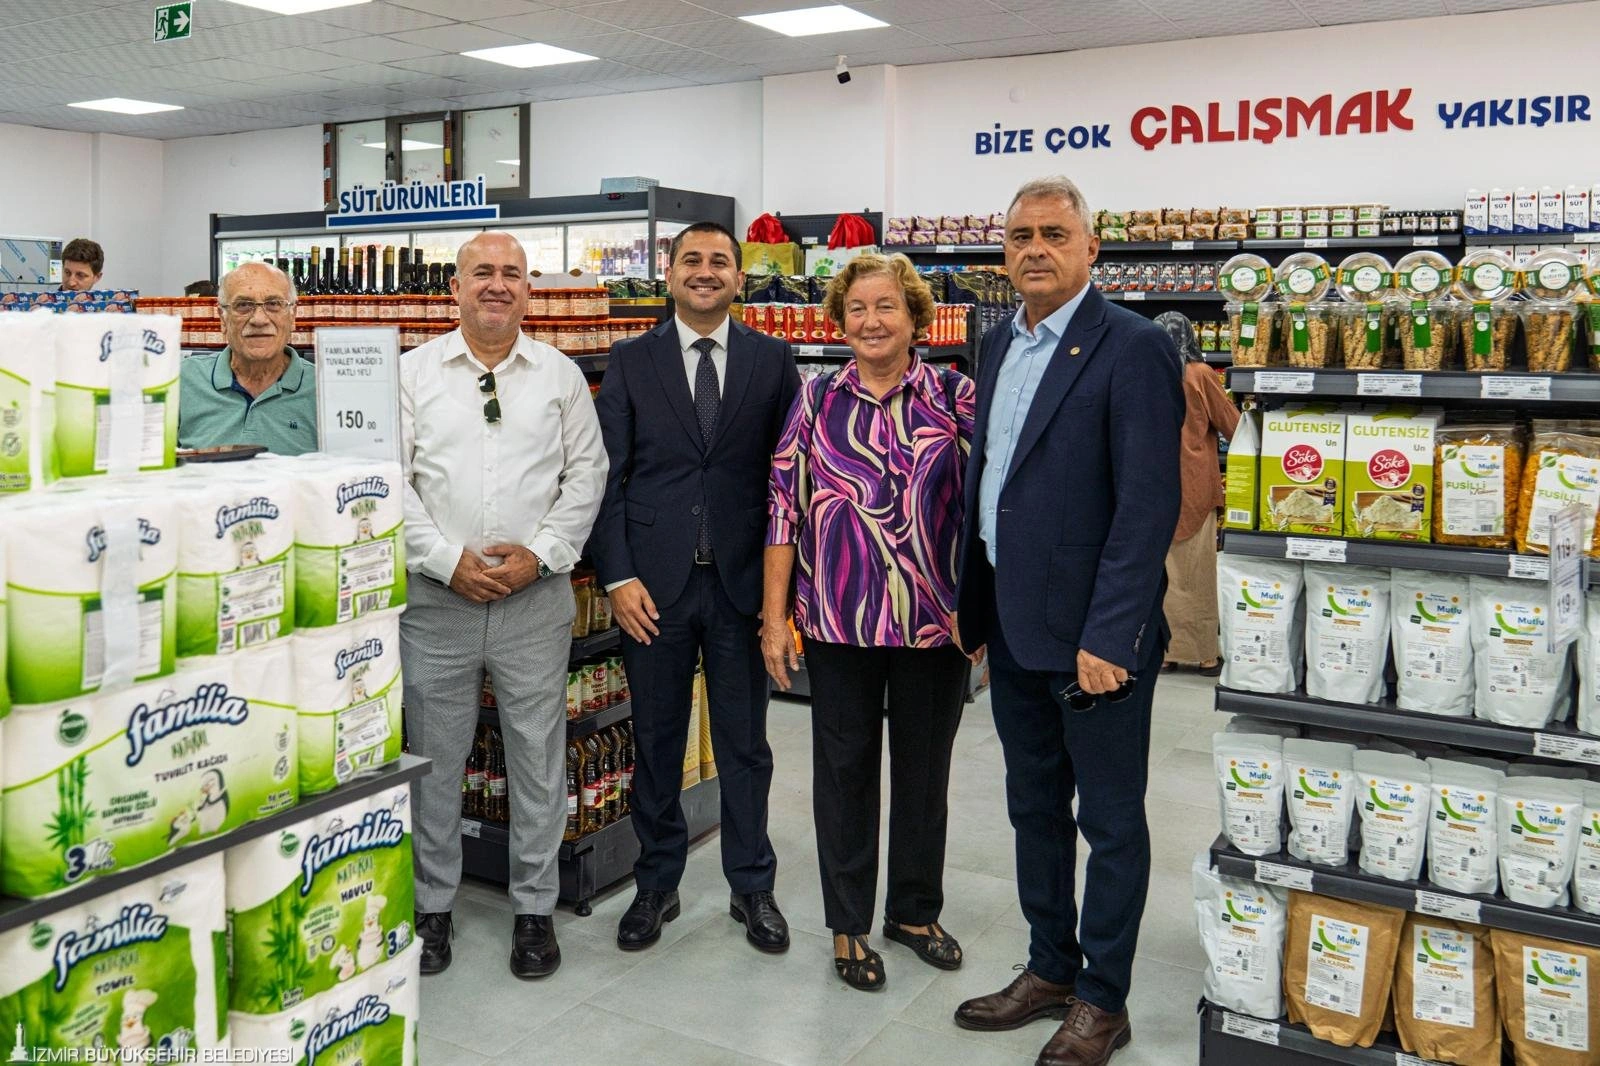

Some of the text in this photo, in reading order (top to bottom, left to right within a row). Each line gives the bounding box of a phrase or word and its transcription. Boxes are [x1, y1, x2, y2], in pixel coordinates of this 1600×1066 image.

[974, 88, 1592, 155] BİZE ÇOK ÇALIŞMAK YAKIŞIR
[340, 176, 484, 214] SÜT ÜRÜNLERİ
[1569, 199, 1583, 207] SÜT
[336, 410, 364, 429] 150
[1268, 421, 1341, 434] GLUTENSİZ
[1353, 425, 1429, 439] GLUTENSİZ
[1326, 439, 1337, 447] Un
[1413, 444, 1426, 452] Un
[1286, 450, 1318, 467] Söke
[1372, 455, 1406, 472] Söke
[336, 476, 390, 514] familia
[215, 497, 280, 540] familia
[1260, 591, 1284, 601] Mutlu
[1347, 598, 1372, 608] Mutlu
[1436, 605, 1463, 615] Mutlu
[1517, 616, 1545, 626] Mutlu
[126, 683, 248, 767] familia
[1249, 771, 1272, 782] Mutlu
[1318, 780, 1342, 790] Mutlu
[1389, 792, 1415, 803] Mutlu
[1462, 802, 1488, 814] Mutlu
[1538, 815, 1566, 826] Mutlu
[300, 809, 404, 897] familia
[66, 847, 86, 879] 3
[340, 881, 373, 904] HAVLU
[1243, 904, 1267, 916] Mutlu
[387, 931, 397, 956] 3
[1336, 935, 1361, 947] Mutlu
[54, 903, 168, 993] familia
[1441, 942, 1467, 954] Mutlu
[1554, 965, 1582, 978] Mutlu
[96, 975, 135, 996] TOWEL
[305, 995, 390, 1066] familia
